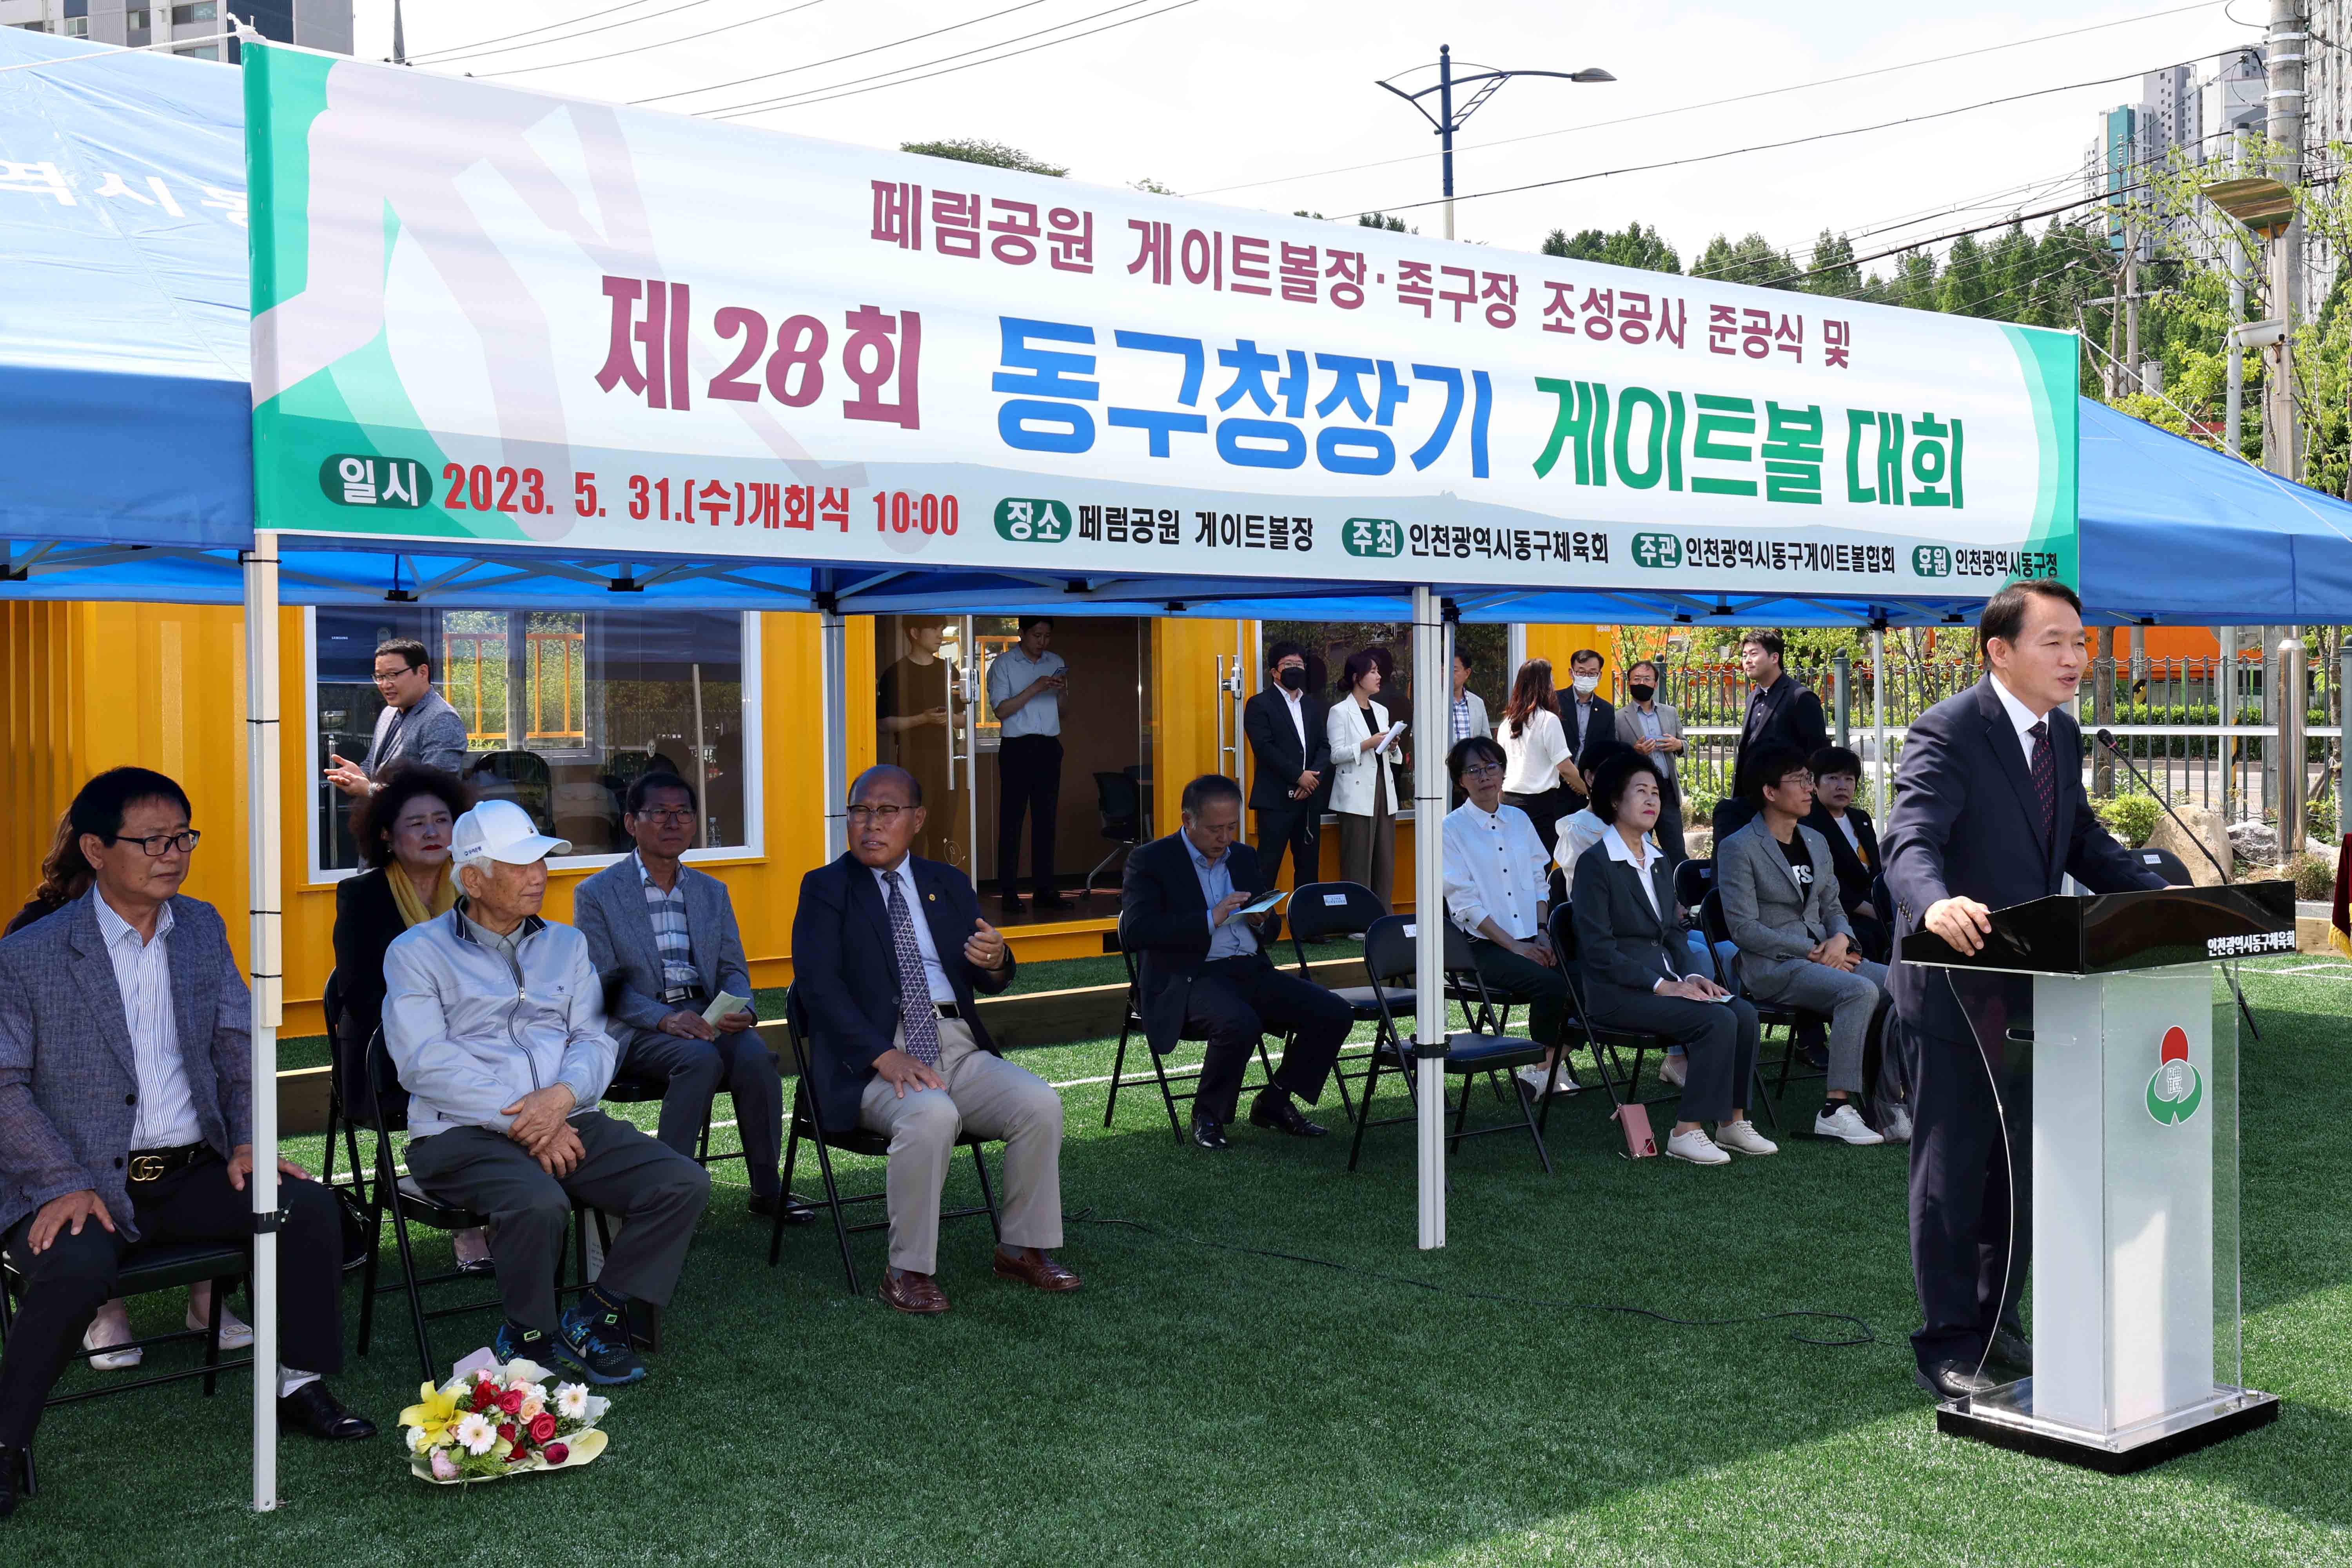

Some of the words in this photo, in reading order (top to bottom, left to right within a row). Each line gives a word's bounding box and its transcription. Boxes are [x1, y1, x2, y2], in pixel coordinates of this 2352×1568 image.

[871, 180, 1094, 274] 페럼공원
[1127, 219, 1518, 329] 게이트볼장·족구장
[1542, 281, 1686, 349] 조성공사
[1709, 304, 1803, 363] 준공식
[1824, 319, 1849, 368] 및
[594, 274, 921, 430] 제28회
[992, 316, 1492, 479] 동구청장기
[1532, 377, 1824, 505] 게이트볼
[1846, 408, 1964, 509] 대회
[339, 457, 418, 506] 일시
[443, 463, 554, 515] 2023.
[575, 472, 606, 517] 5.
[873, 491, 958, 536] 10:00
[1007, 501, 1062, 540] 장소
[1078, 505, 1180, 545] 페럼공원
[1195, 511, 1313, 552] 게이트볼장
[1352, 521, 1396, 556] 주최
[1409, 523, 1609, 564] 인천광역시동구체육회
[1640, 535, 1676, 567] 주관
[1686, 537, 1895, 574] 인천광역시동구게이트볼협회
[1918, 548, 1947, 575] 후원
[1955, 549, 2058, 577] 인천광역시동구청
[2207, 930, 2295, 956] 인천광역시동구체육회
